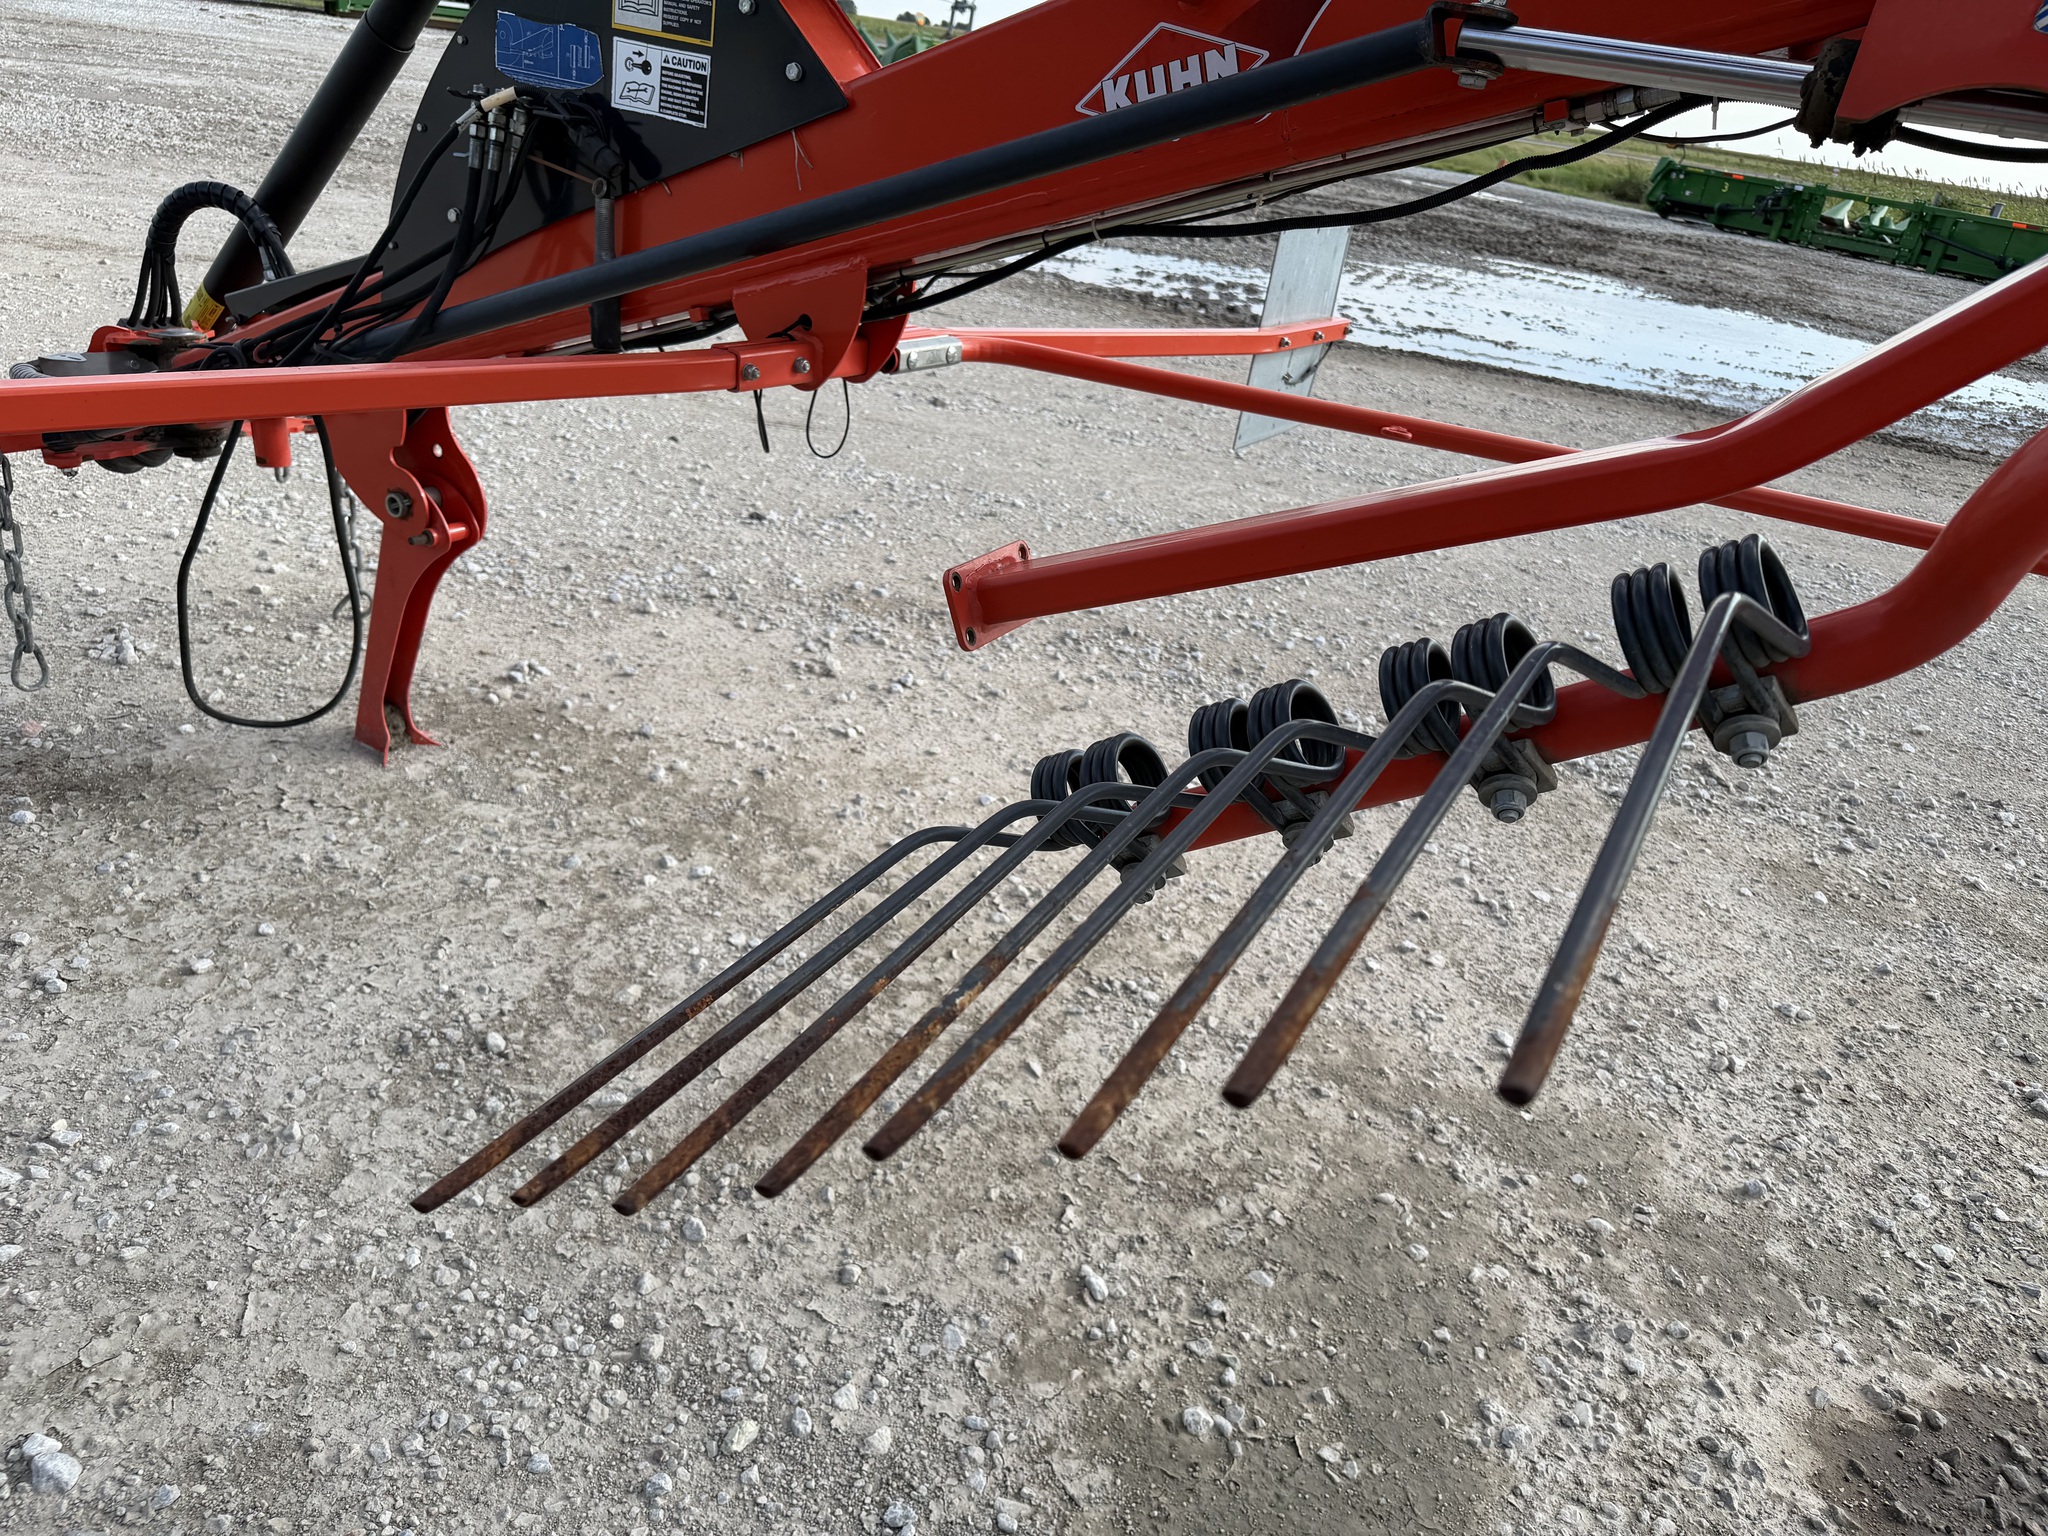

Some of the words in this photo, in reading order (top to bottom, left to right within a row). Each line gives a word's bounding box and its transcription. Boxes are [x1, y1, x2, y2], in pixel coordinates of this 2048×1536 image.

[671, 56, 707, 72] CAUTION
[1102, 43, 1239, 113] KUHN
[1722, 182, 1729, 192] 3
